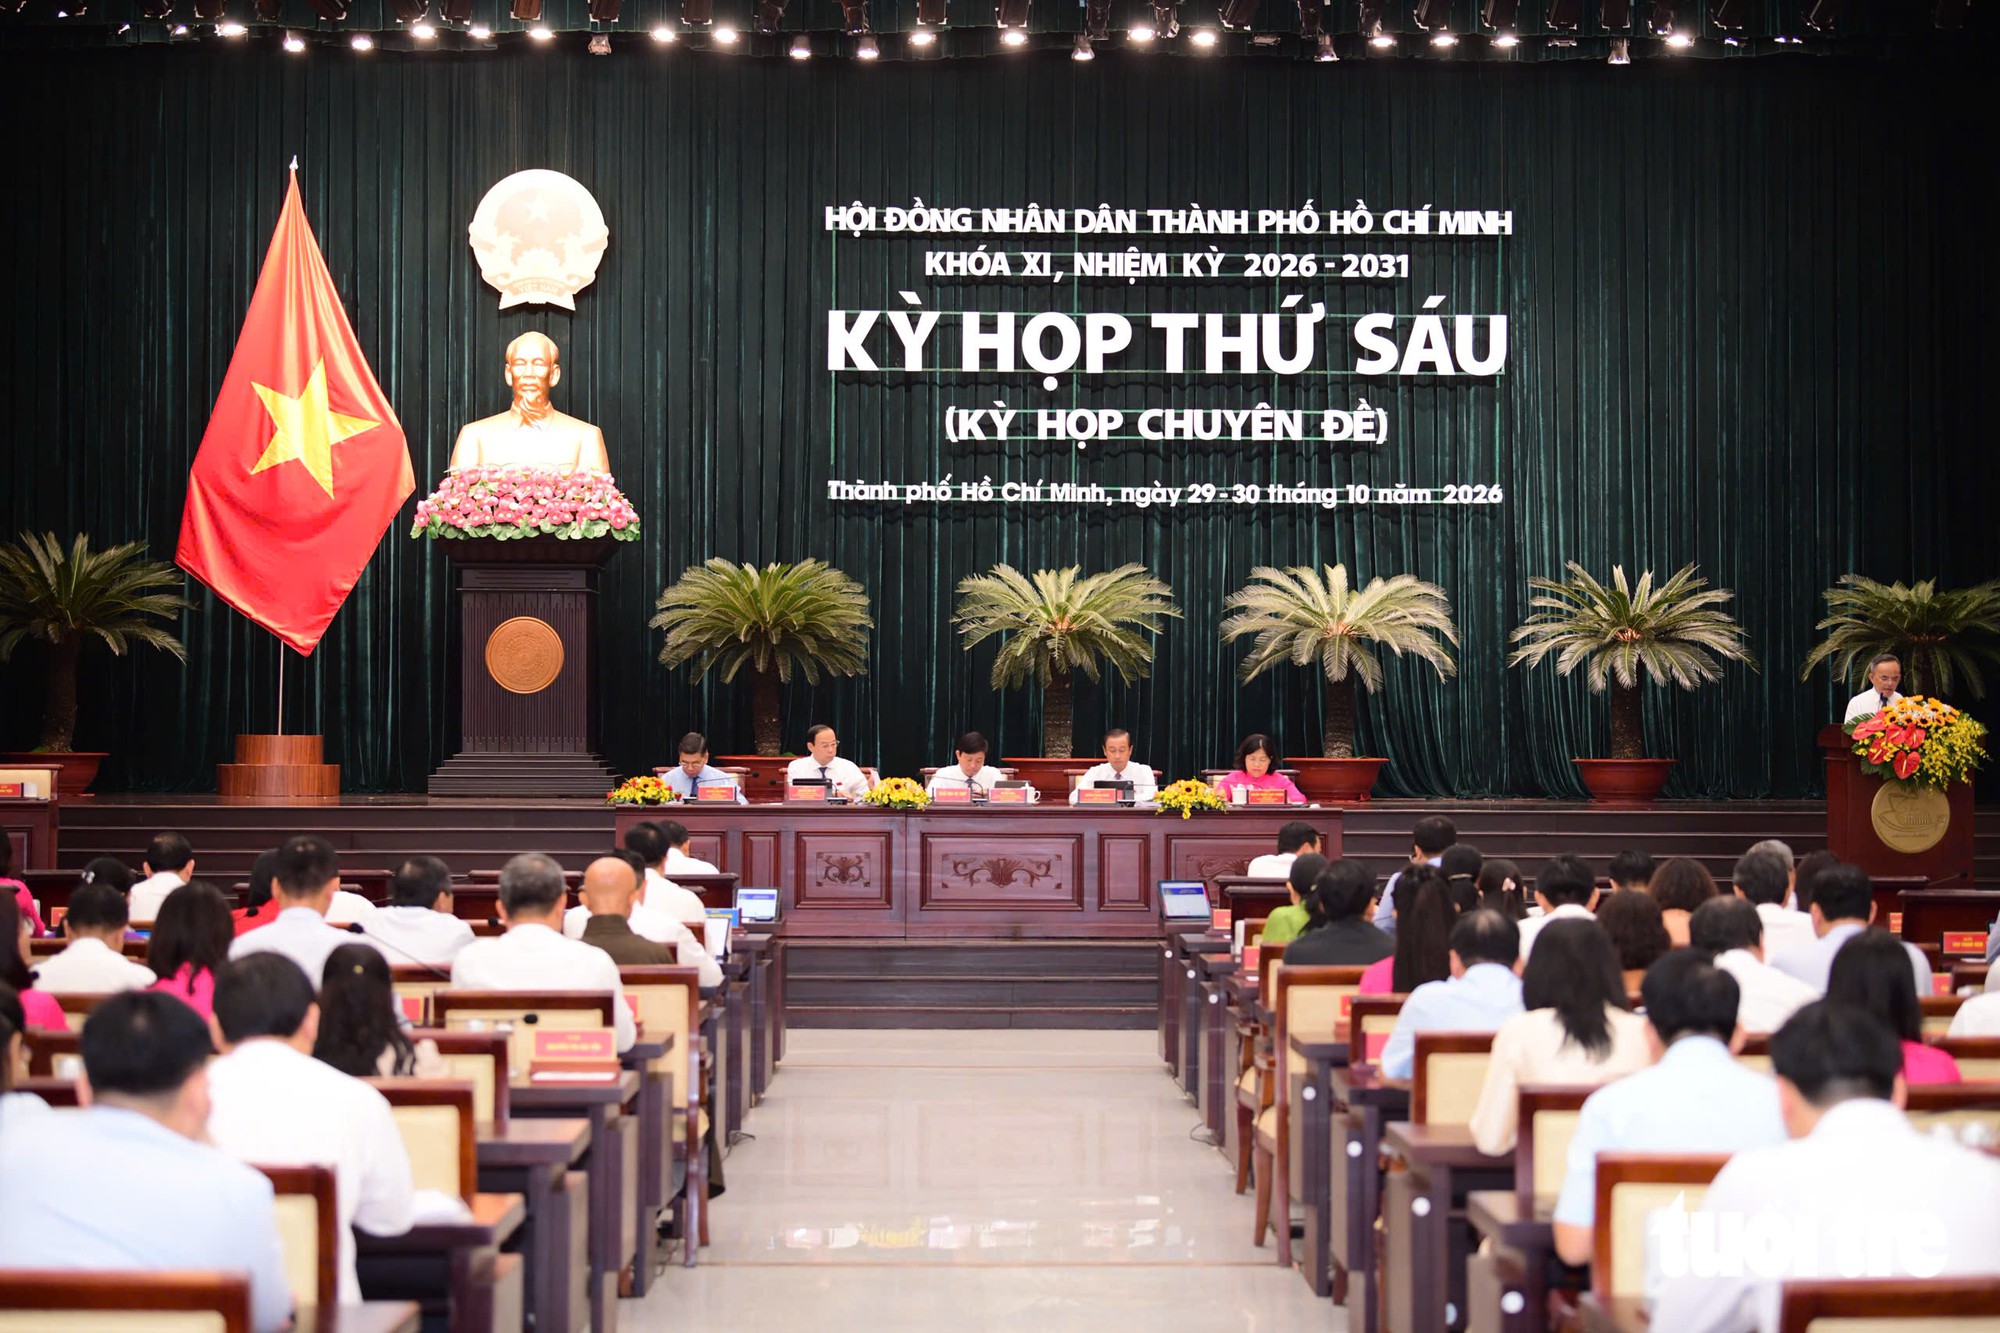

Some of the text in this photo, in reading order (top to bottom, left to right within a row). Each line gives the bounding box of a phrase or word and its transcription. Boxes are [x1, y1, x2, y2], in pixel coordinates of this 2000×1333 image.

[825, 197, 1513, 238] HỘI ĐỒNG NHÂN DÂN THÀNH PHỐ HỒ CHÍ MINH
[925, 244, 1012, 277] KHÓA
[1074, 246, 1168, 285] NHIỆM
[1182, 245, 1226, 278] KỲ
[1243, 253, 1318, 278] 2026
[1341, 253, 1409, 278] 2031
[827, 290, 1508, 392] KỲ HỌP THỨ SÁU
[945, 397, 1388, 450] (KỲ HỌP CHUYÊN ĐỀ)
[827, 478, 898, 501] Thành
[905, 473, 952, 505] phố
[959, 475, 994, 502] Hồ
[1001, 478, 1044, 502] Chí
[1049, 481, 1113, 507] Minh,
[1120, 480, 1183, 508] ngày
[1267, 480, 1340, 509] tháng
[1345, 484, 1370, 504] 10
[1378, 483, 1432, 504] năm
[1442, 483, 1504, 505] 2026
